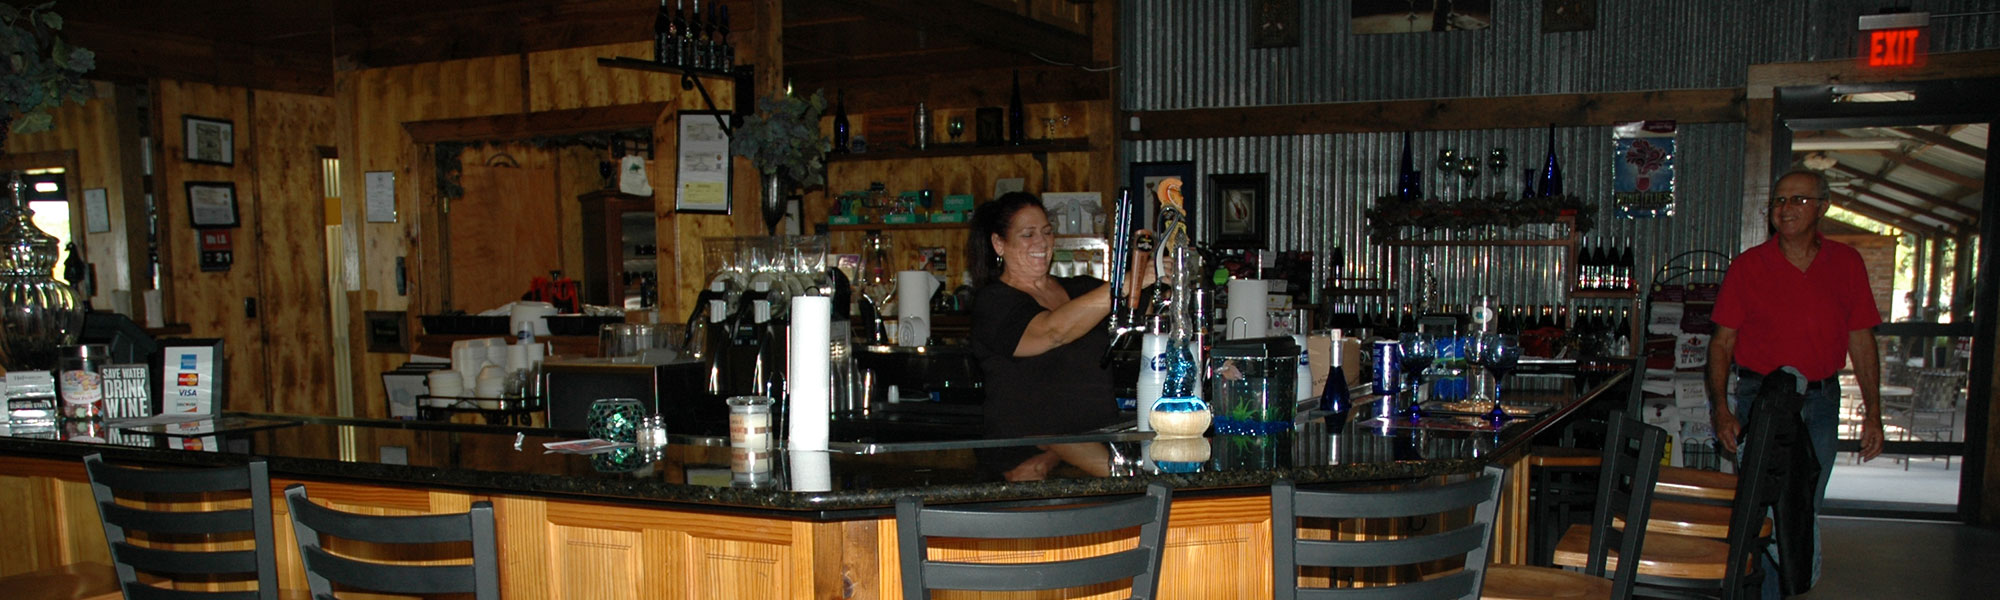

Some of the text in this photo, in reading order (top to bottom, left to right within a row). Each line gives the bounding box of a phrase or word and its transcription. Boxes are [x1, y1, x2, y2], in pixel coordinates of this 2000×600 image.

[1869, 29, 1919, 66] EXIT
[1644, 192, 1672, 203] FLIES
[216, 252, 230, 263] 21
[102, 367, 146, 379] SAVE WATER
[104, 379, 147, 398] DRINK
[179, 389, 197, 397] VISA
[105, 397, 149, 418] WINE
